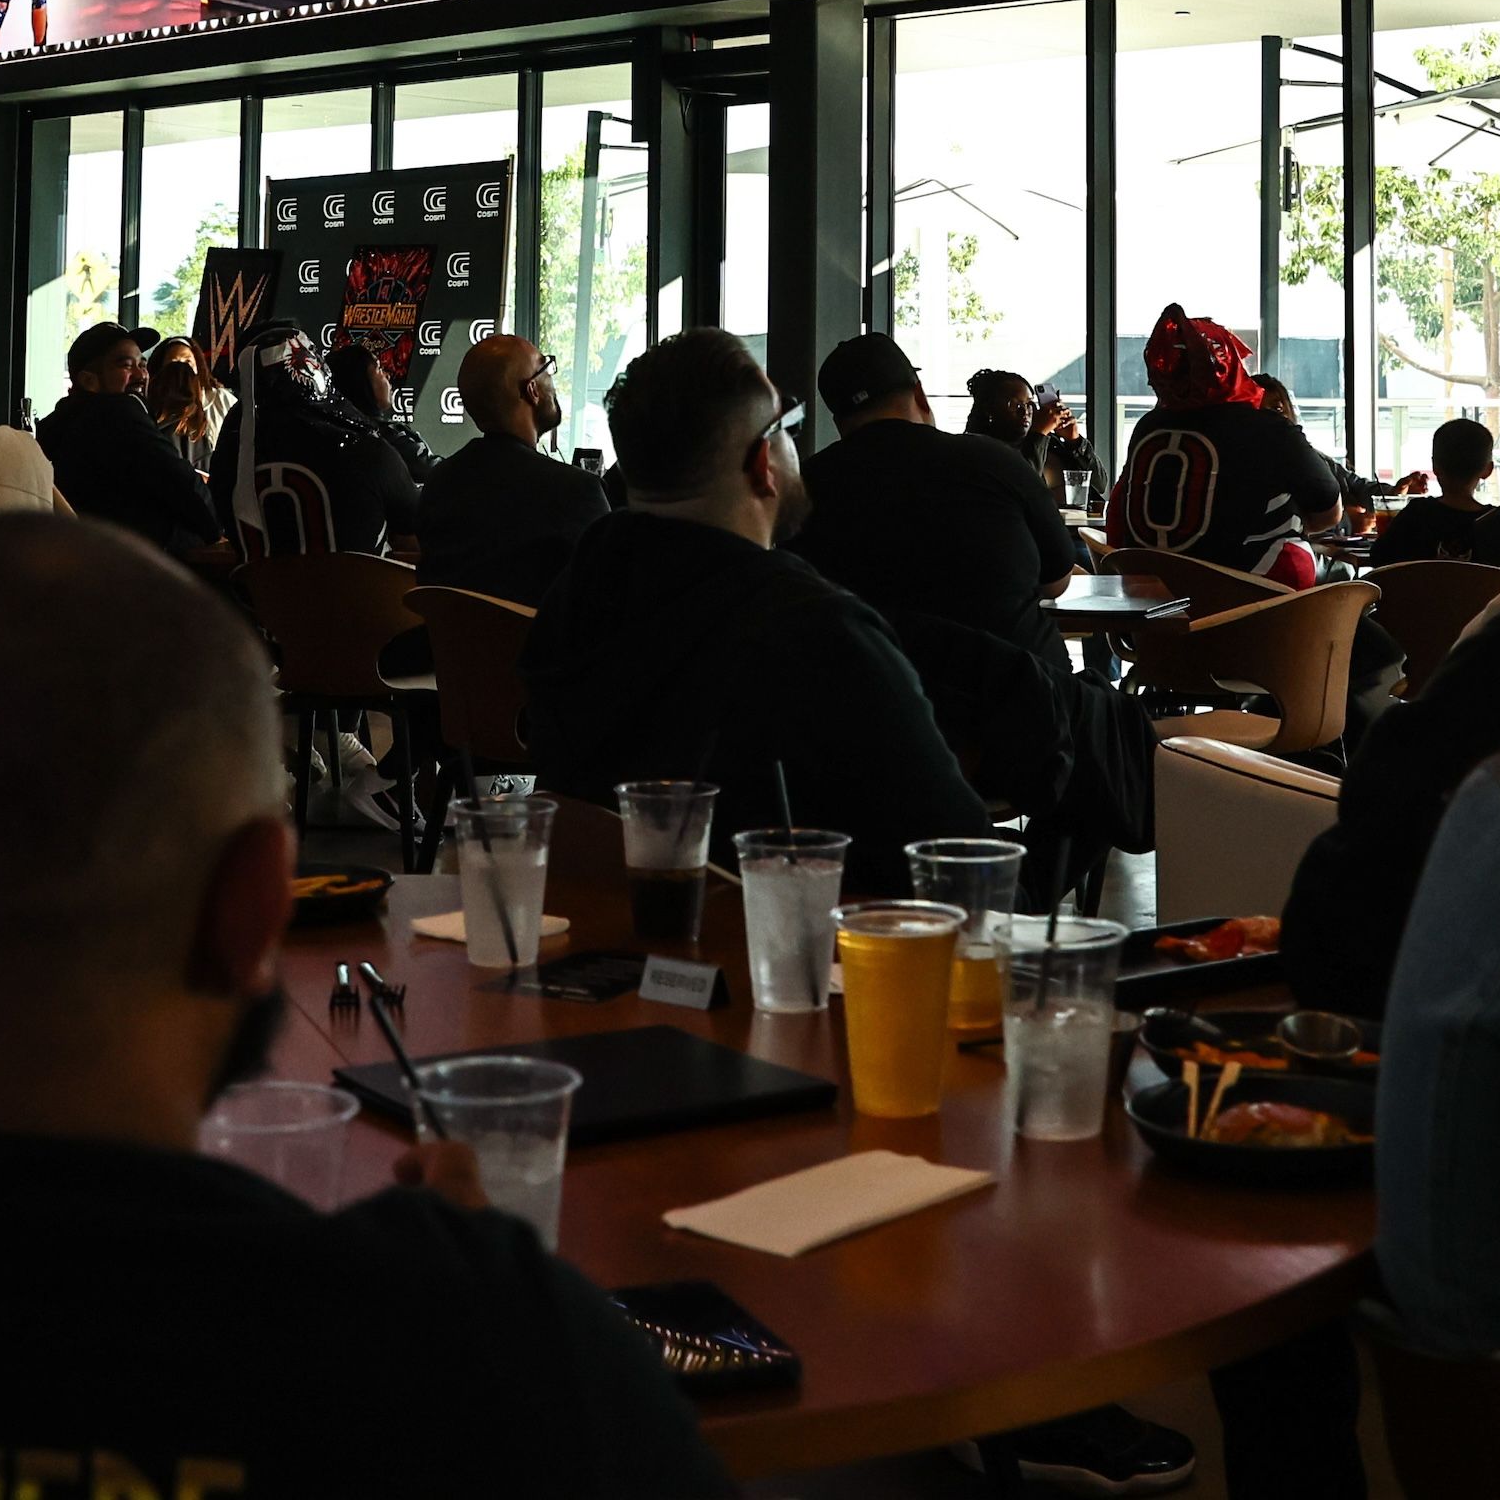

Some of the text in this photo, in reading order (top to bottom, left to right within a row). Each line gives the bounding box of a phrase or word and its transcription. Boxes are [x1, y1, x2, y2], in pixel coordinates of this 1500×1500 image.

[423, 213, 446, 222] Cosm
[476, 209, 499, 218] Cosm
[324, 220, 345, 228] Cosm
[372, 216, 394, 225] Cosm
[276, 223, 297, 231] Cosm
[447, 279, 470, 287] Cosm
[299, 285, 320, 293] Cosm
[419, 347, 441, 356] Cosm
[440, 414, 464, 423] Cosm
